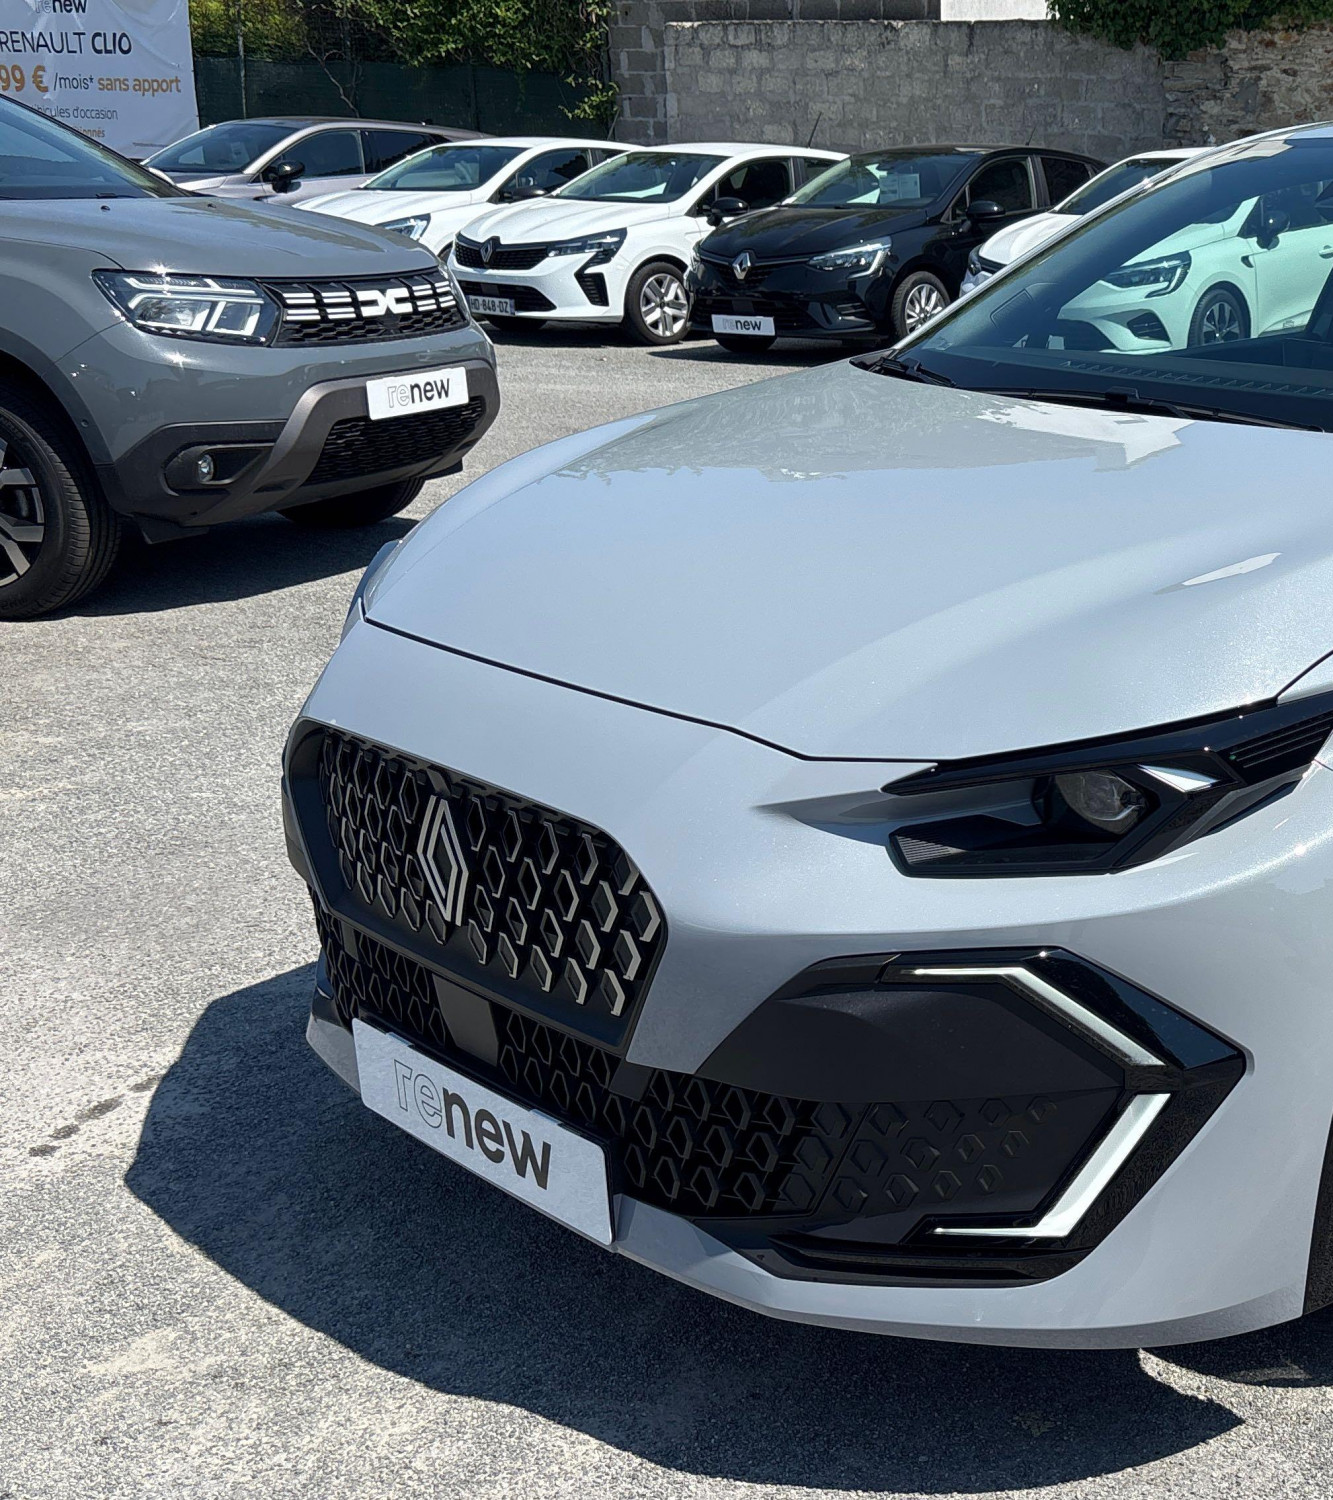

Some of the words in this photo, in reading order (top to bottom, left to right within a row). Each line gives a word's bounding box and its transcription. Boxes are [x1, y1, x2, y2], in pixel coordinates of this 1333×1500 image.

[0, 31, 86, 54] RENAULT
[91, 32, 132, 55] CLIO
[32, 65, 49, 93] €
[98, 77, 129, 92] sans
[132, 76, 182, 97] apport
[72, 105, 119, 120] d'occasion
[387, 378, 451, 408] renew
[394, 1059, 552, 1191] renew
